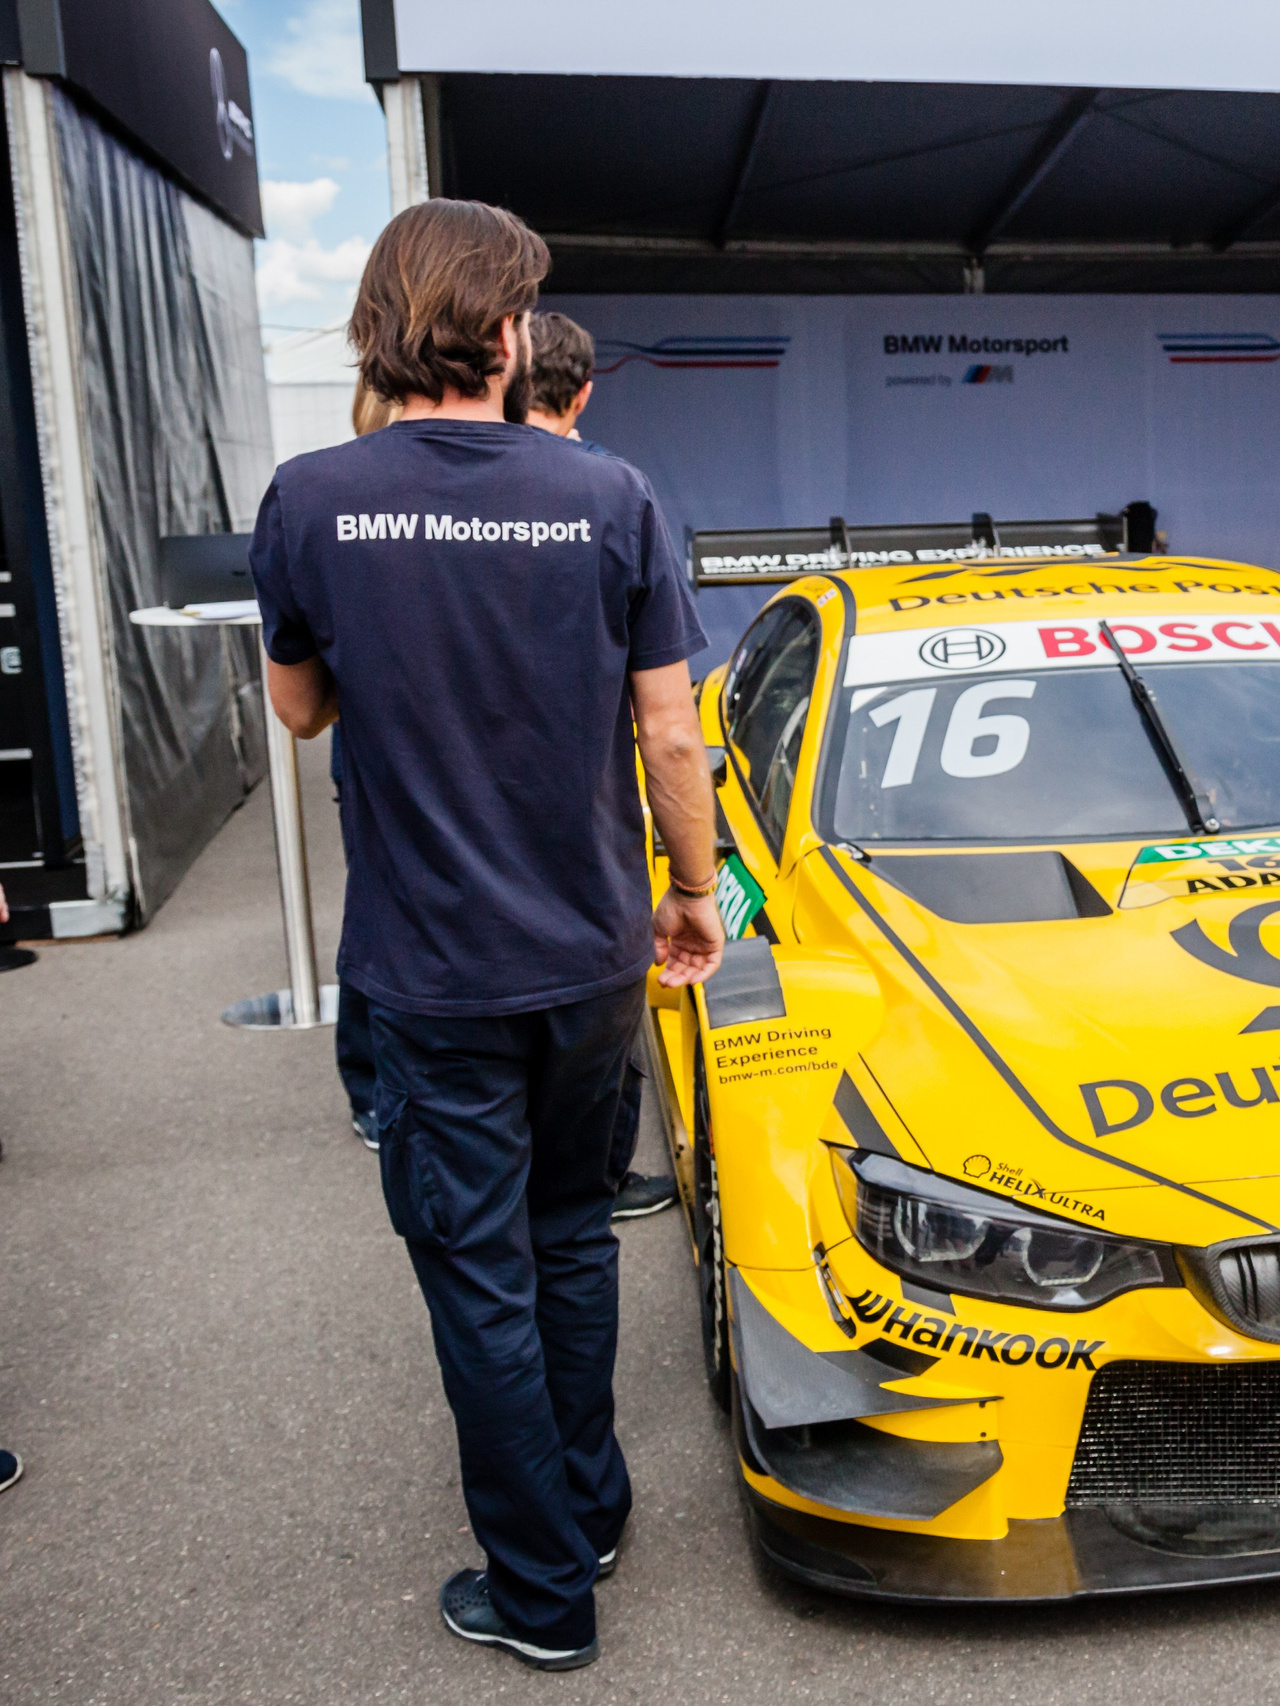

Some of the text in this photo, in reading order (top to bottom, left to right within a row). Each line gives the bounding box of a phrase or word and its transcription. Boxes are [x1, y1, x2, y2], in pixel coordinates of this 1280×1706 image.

[884, 335, 1068, 356] BMW Motorsport
[337, 514, 591, 547] BMW Motorsport
[701, 554, 781, 569] BMW
[889, 581, 1157, 611] Deutsche
[868, 680, 1037, 789] 16
[713, 1028, 832, 1051] BMW Driving
[716, 1046, 818, 1069] Experience
[719, 1060, 838, 1085] bmw-m.com/bde
[996, 1162, 1024, 1177] Shell
[989, 1171, 1106, 1221] HELIX ULTRA
